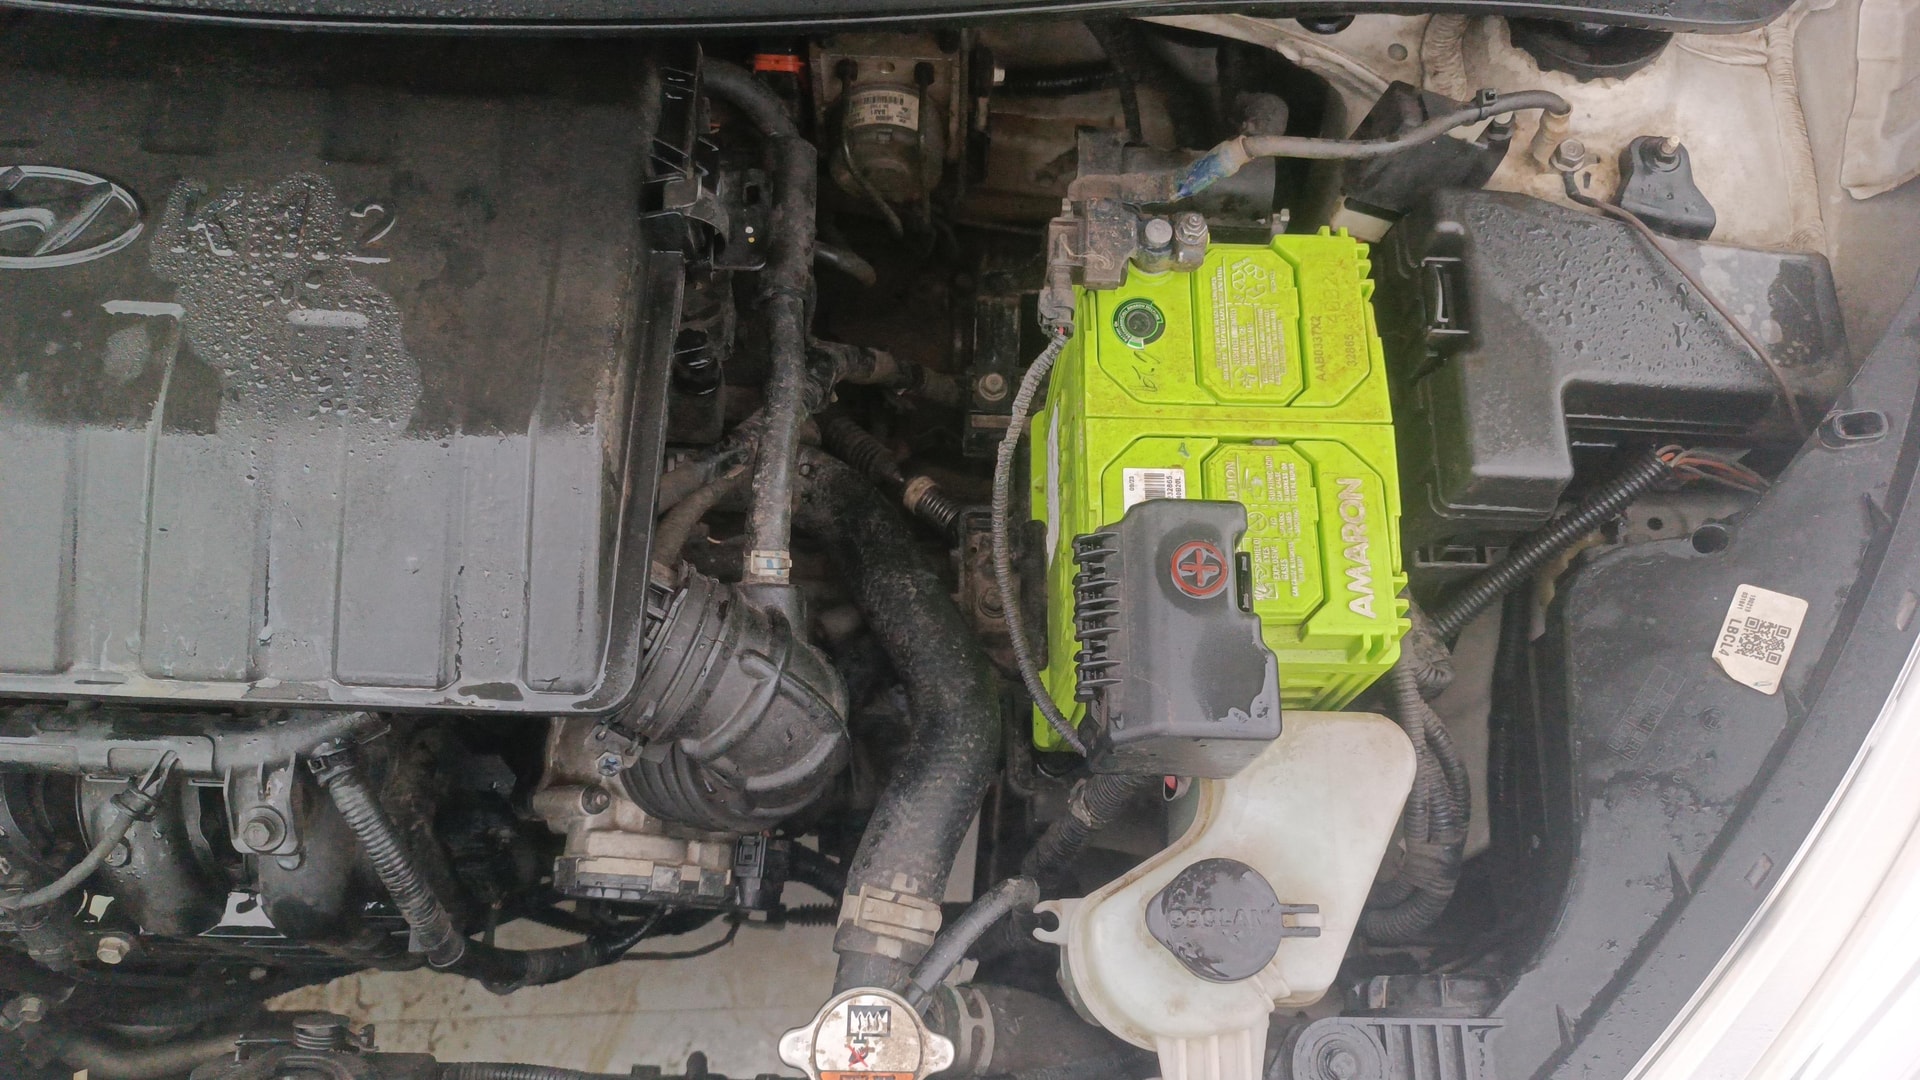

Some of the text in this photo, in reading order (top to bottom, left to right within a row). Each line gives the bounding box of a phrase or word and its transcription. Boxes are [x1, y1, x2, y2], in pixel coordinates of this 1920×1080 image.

[1343, 334, 1358, 367] 32865
[1166, 475, 1174, 499] 32865
[1226, 462, 1238, 499] UTION
[1336, 478, 1377, 619] AMARON
[1718, 618, 1742, 657] LBCL4
